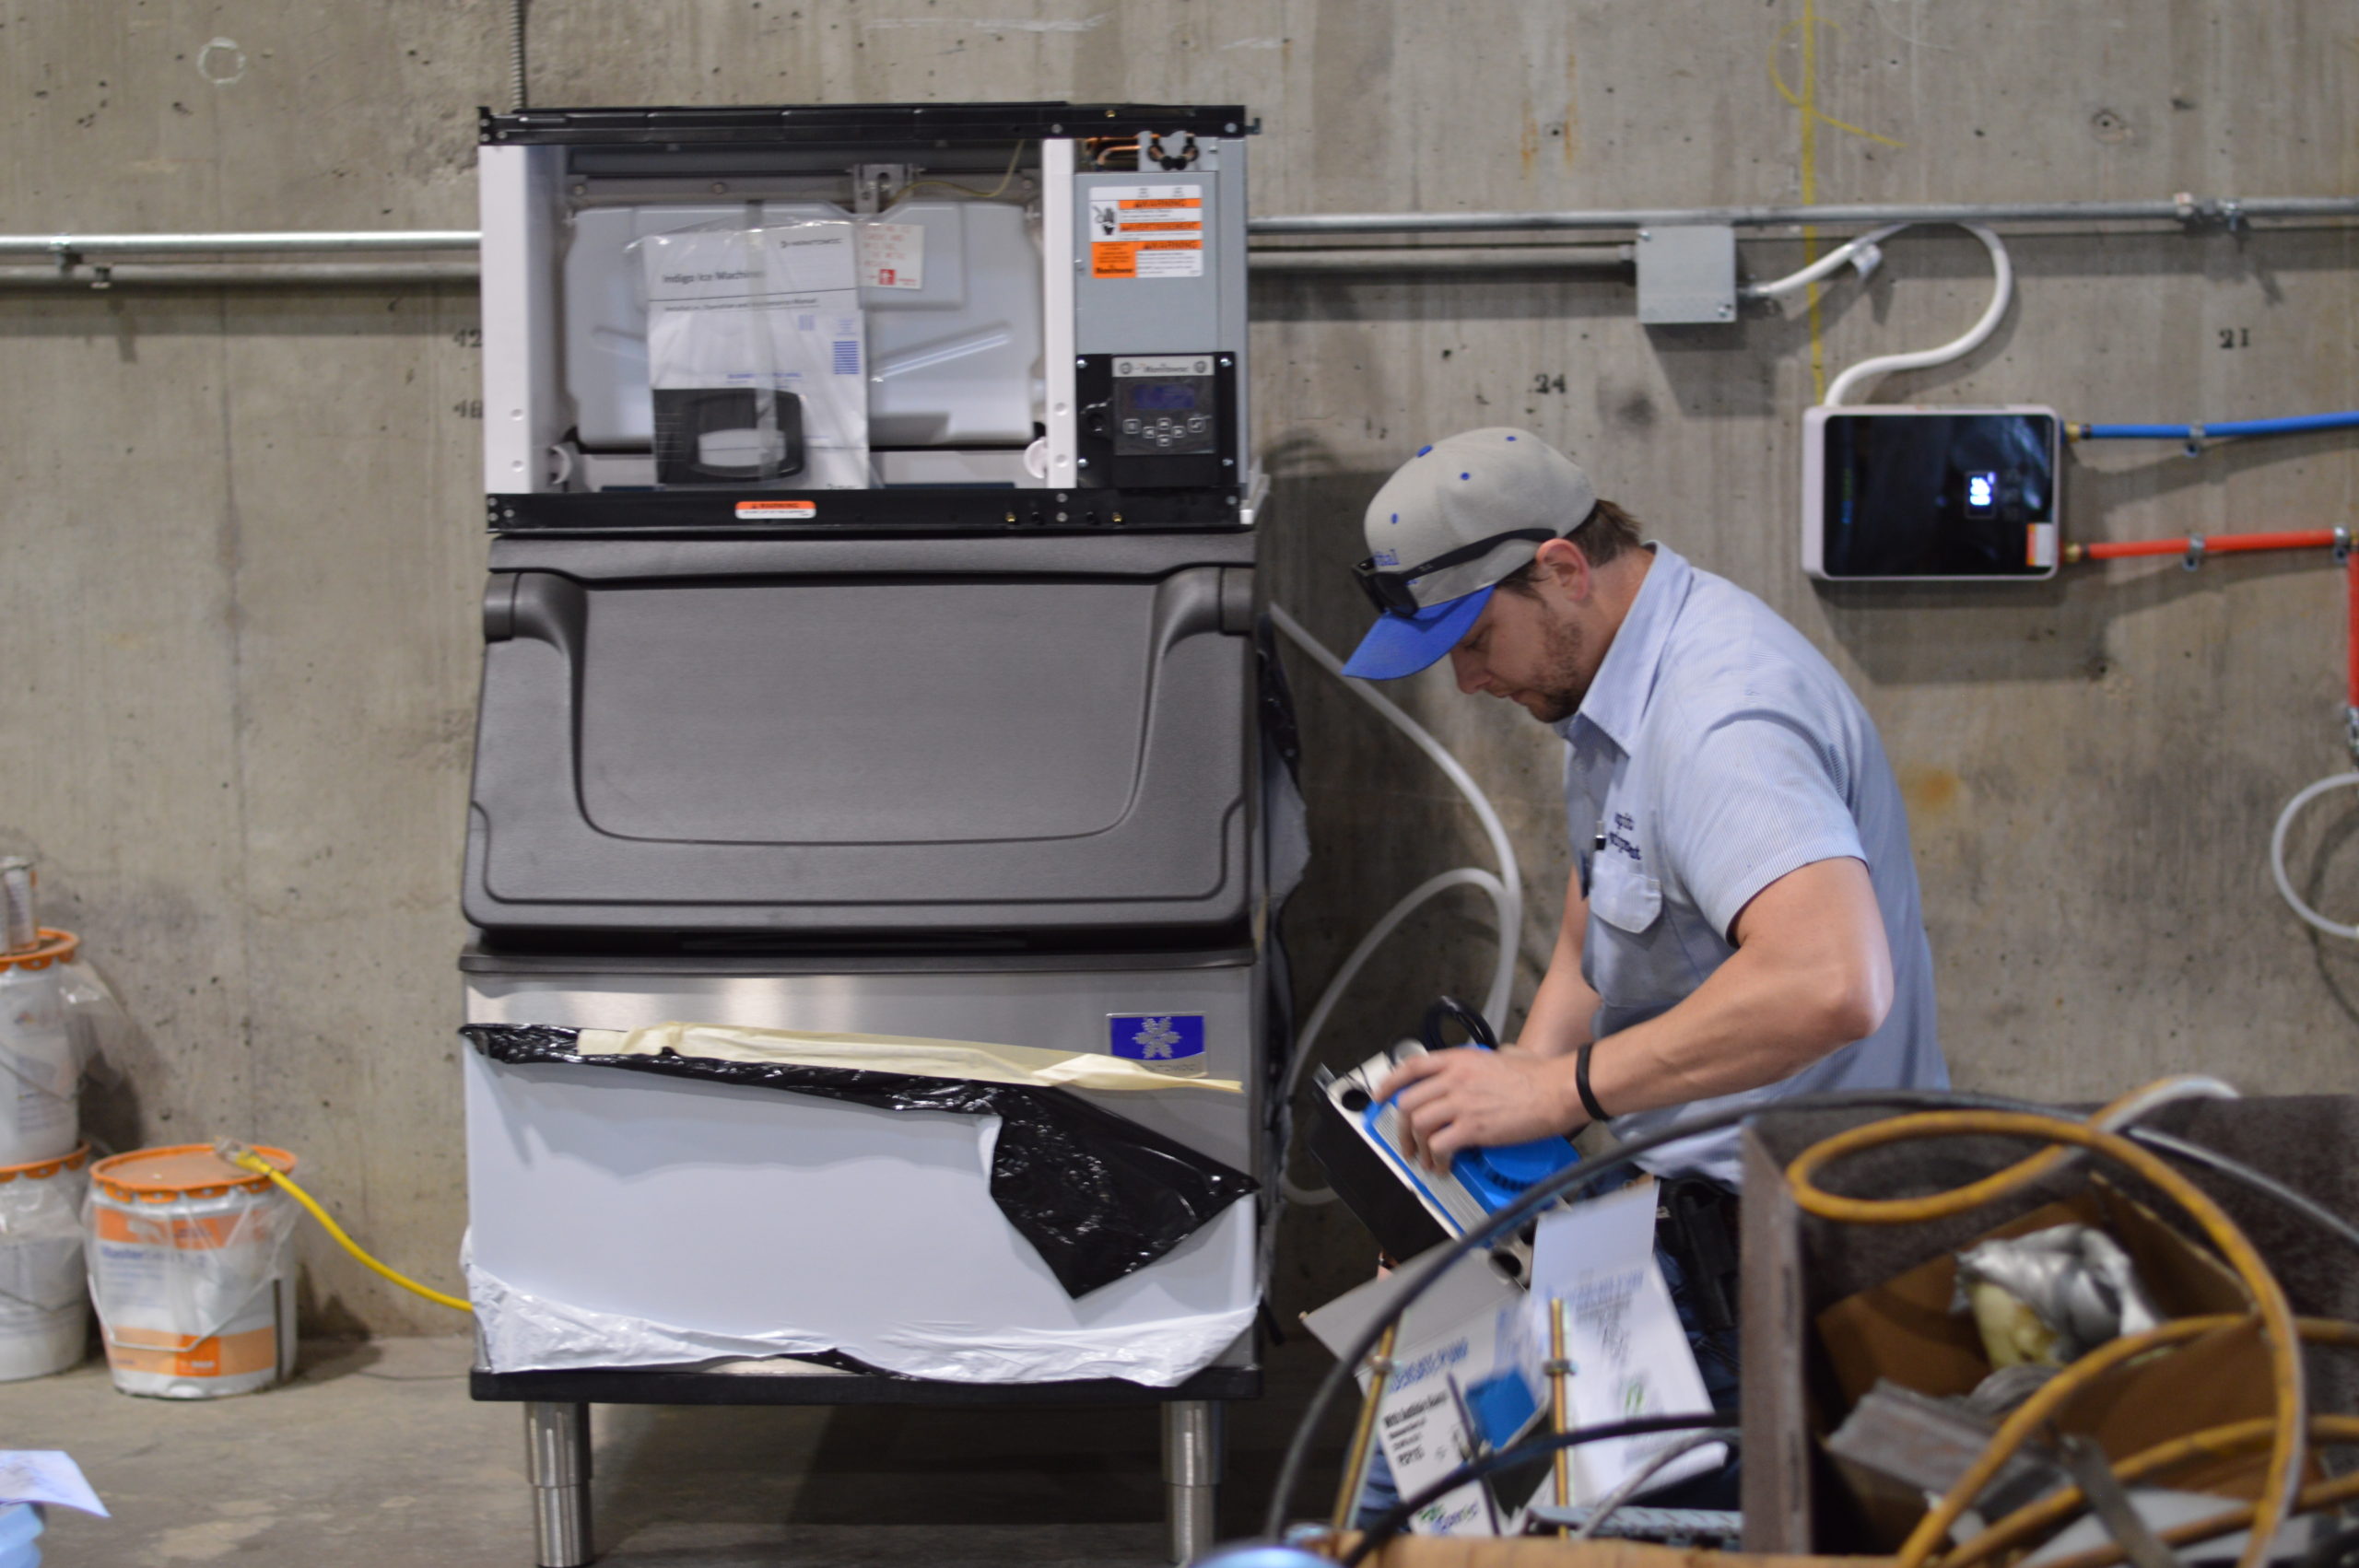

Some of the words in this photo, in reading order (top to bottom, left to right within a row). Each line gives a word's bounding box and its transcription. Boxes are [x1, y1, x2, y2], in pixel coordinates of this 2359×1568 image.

[662, 274, 694, 285] Indigo
[2217, 327, 2249, 350] 21
[1533, 372, 1566, 394] 24
